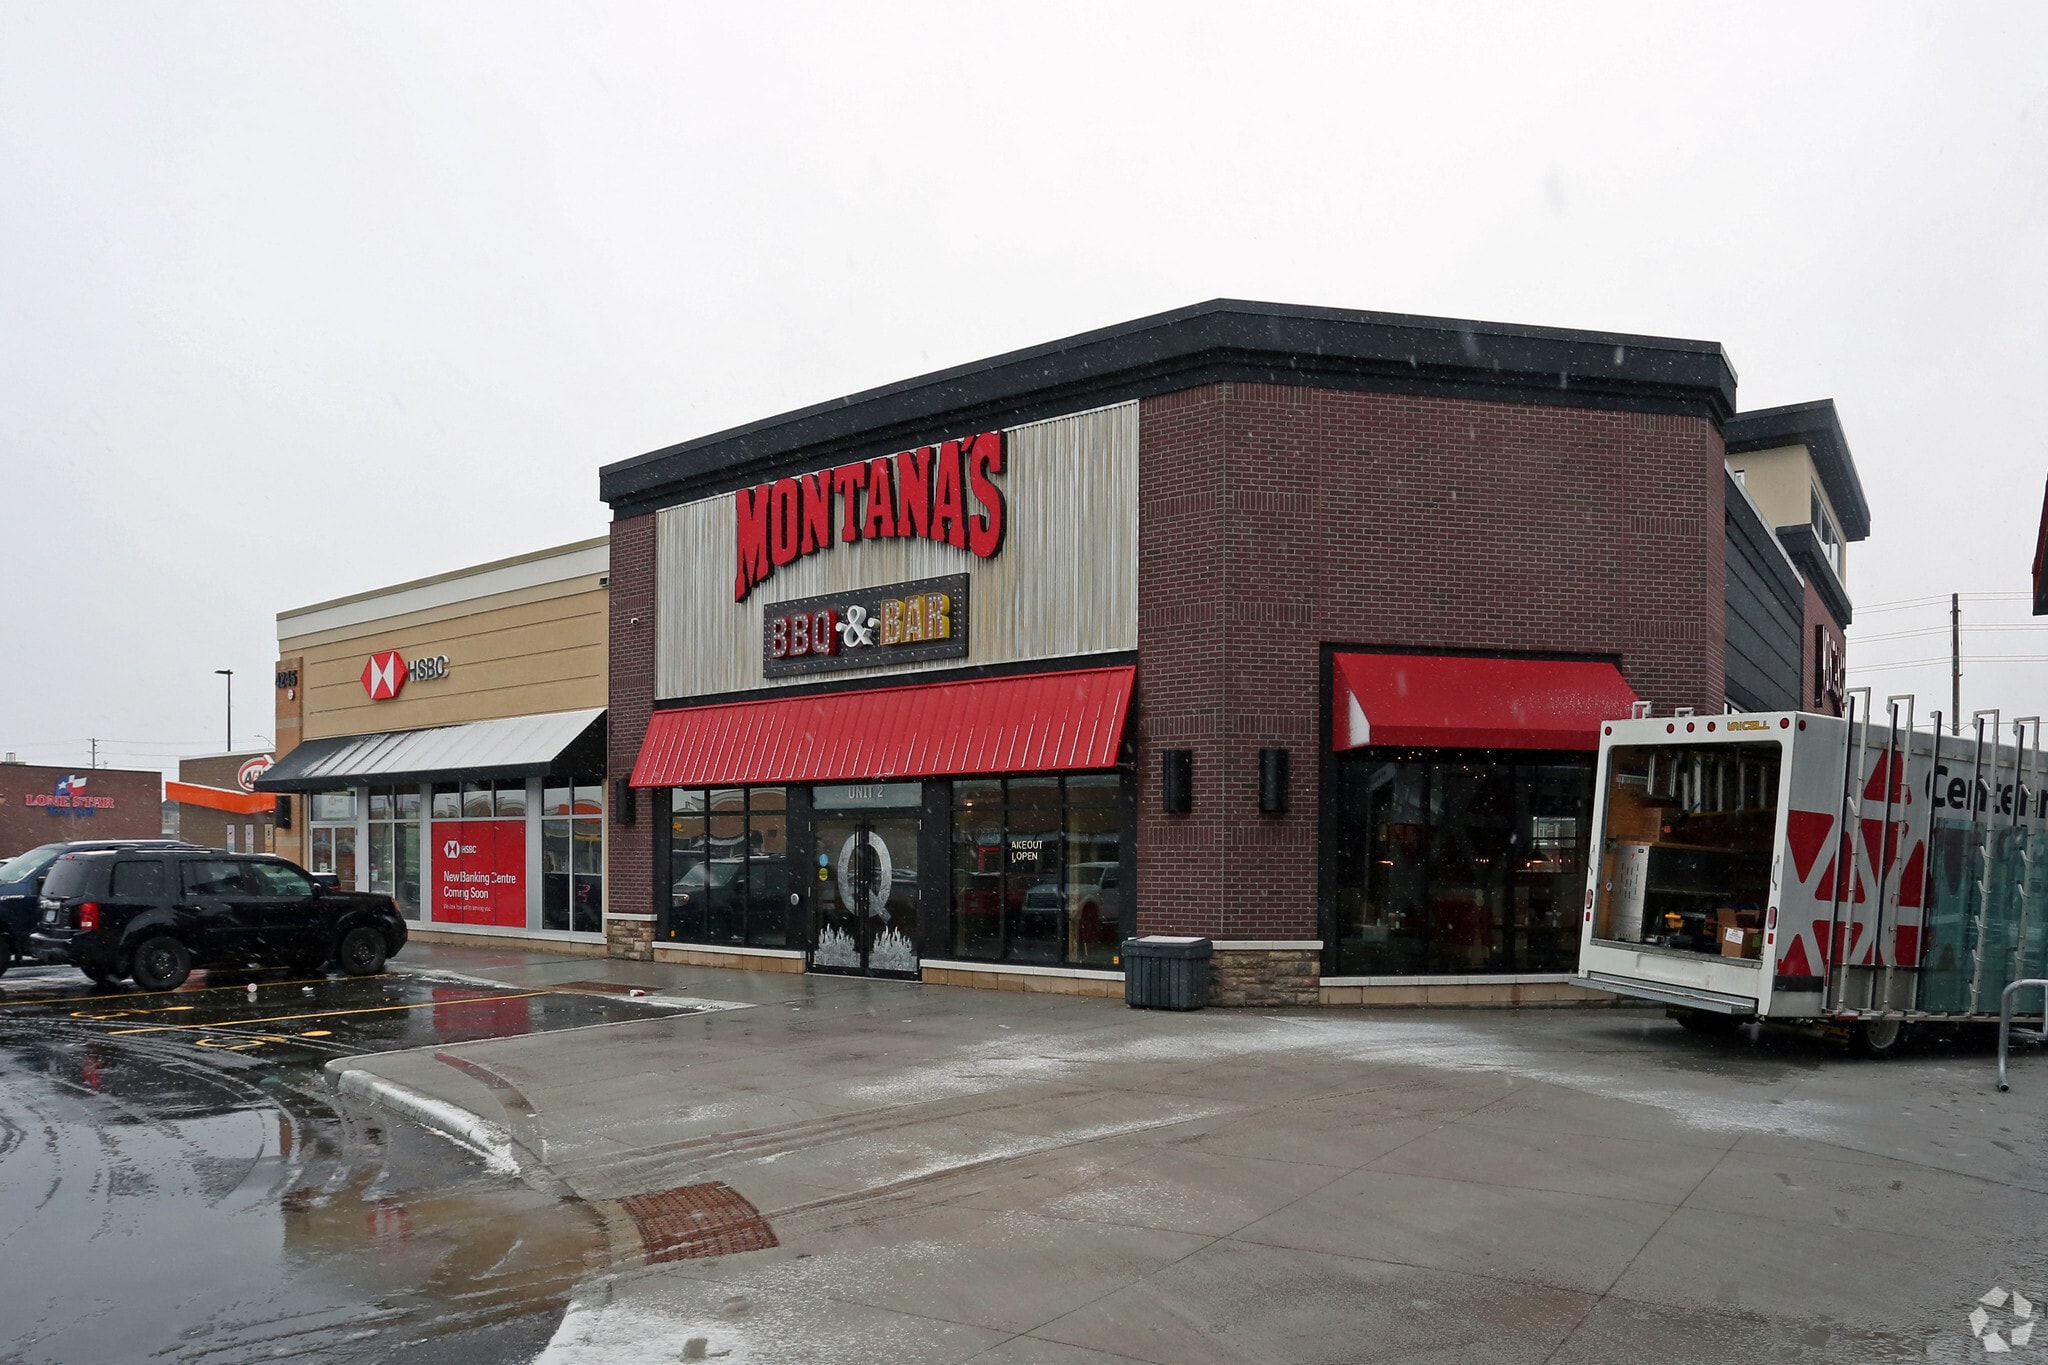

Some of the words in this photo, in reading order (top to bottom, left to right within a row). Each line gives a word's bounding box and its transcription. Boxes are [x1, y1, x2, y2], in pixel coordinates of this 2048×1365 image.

[735, 430, 1006, 602] MONTANA'S
[769, 609, 837, 658] BBQ
[836, 604, 876, 648] &
[880, 592, 950, 646] BAR
[407, 655, 450, 682] HSBC
[848, 785, 874, 799] UNIT
[877, 784, 885, 798] 2
[25, 793, 71, 807] LONE
[72, 795, 115, 809] STAR
[461, 845, 477, 854] HSBC
[1016, 851, 1038, 861] OPEN
[443, 870, 460, 882] New
[460, 871, 490, 886] Banking
[838, 831, 892, 924] Q
[470, 887, 489, 899] Soon
